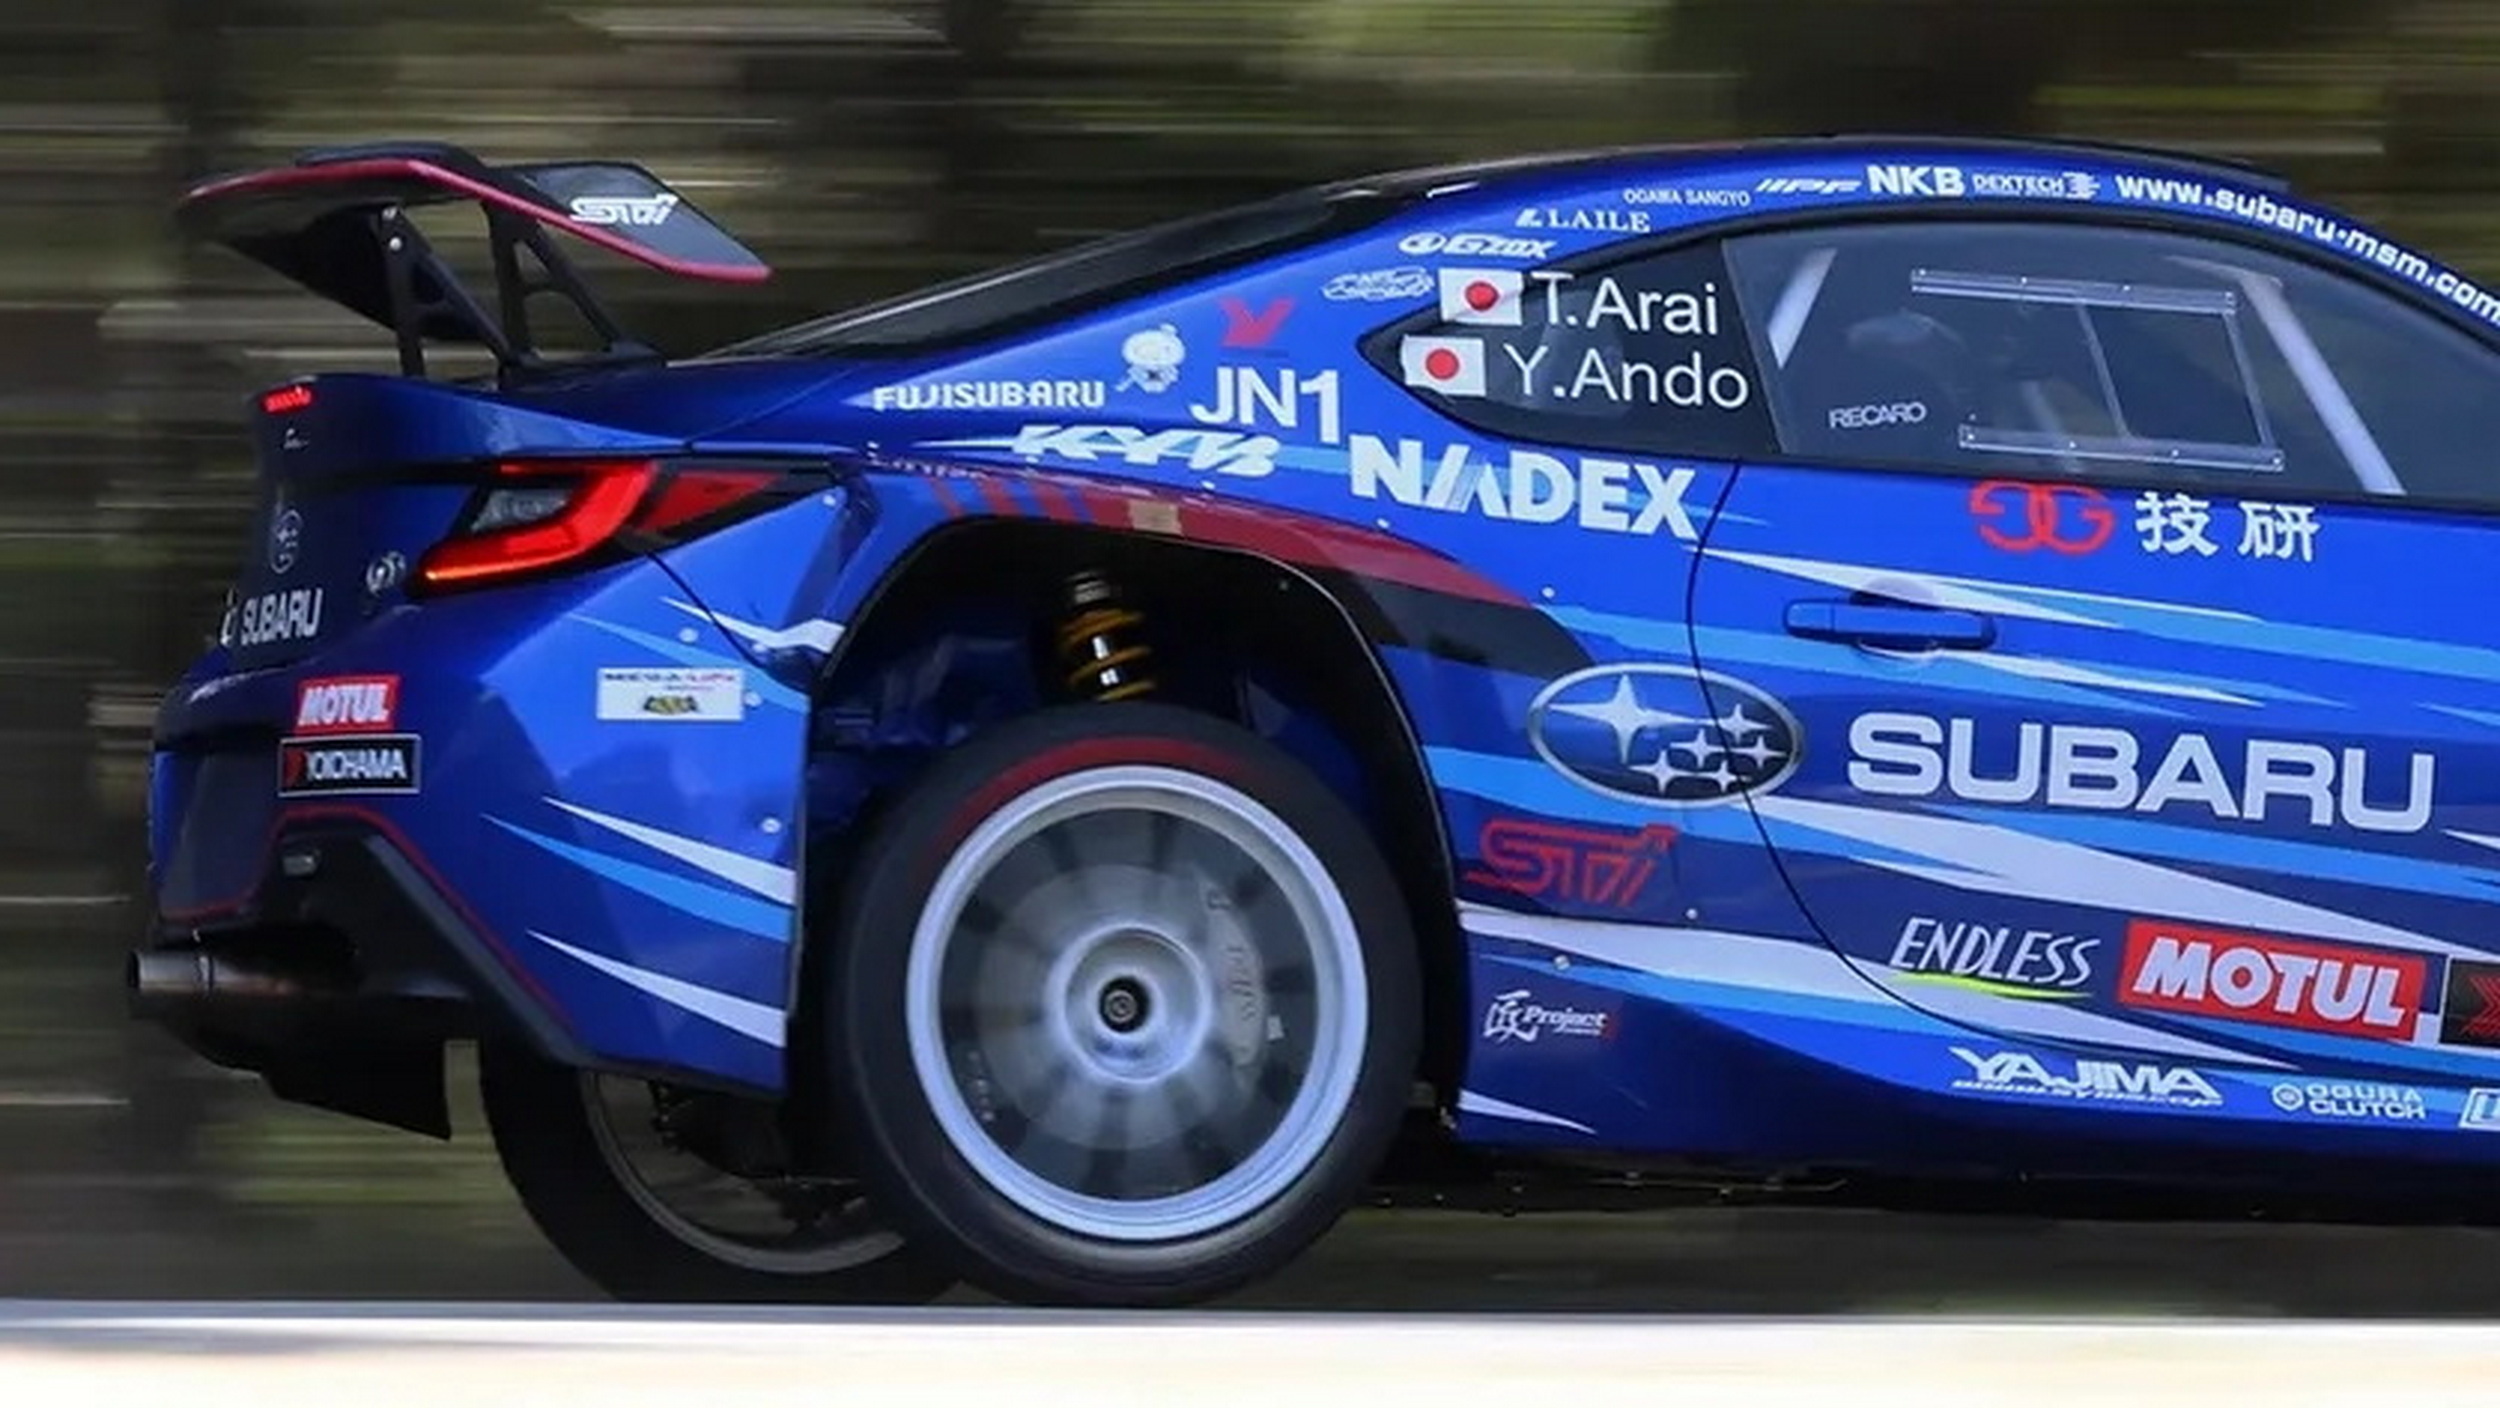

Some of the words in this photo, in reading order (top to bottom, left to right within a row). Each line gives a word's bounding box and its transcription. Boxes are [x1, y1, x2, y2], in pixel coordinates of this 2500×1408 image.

[1867, 164, 1965, 196] NKB
[1530, 270, 1718, 336] T.Arai
[1191, 366, 1340, 445] JN1
[1504, 343, 1750, 410] Y.Ando
[1829, 402, 1926, 429] RECARO
[1012, 425, 1280, 477] KYB
[1350, 433, 1698, 541] NADEX
[2135, 491, 2320, 562] 技研
[240, 587, 323, 646] SUBARU
[297, 681, 390, 727] MOTUL
[1847, 711, 2434, 833] SUBARU
[1890, 916, 2101, 987] ENDLESS
[2132, 936, 2408, 1025] MOTUL
[1948, 1046, 2223, 1100] YAJIMA
[2309, 1099, 2426, 1119] CLUTCH
